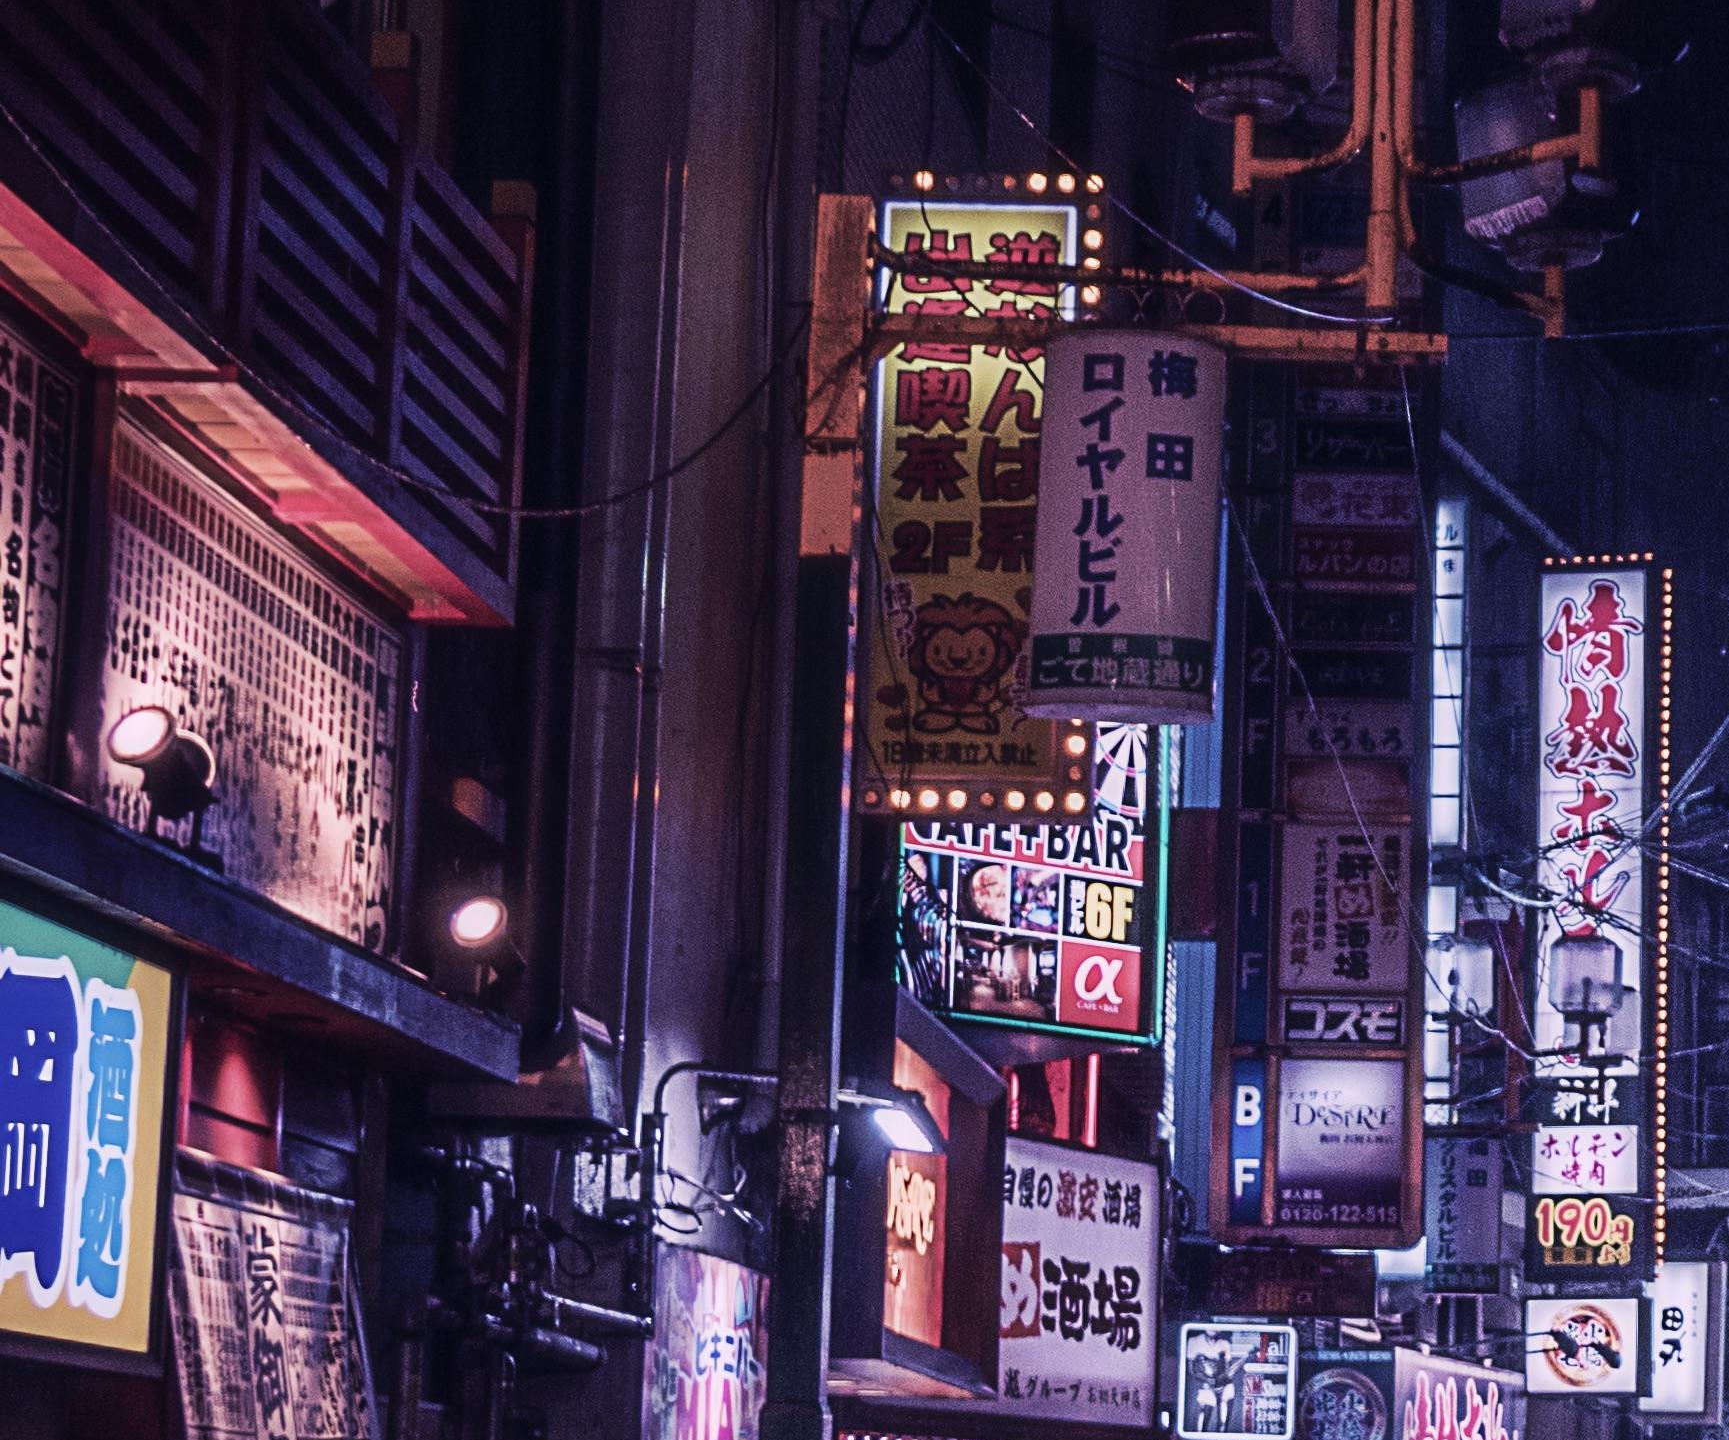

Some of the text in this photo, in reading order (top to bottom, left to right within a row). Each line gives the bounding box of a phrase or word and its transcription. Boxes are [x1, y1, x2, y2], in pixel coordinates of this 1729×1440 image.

[1146, 349, 1199, 482] 梅田
[1069, 352, 1127, 628] ロイヤルビル
[892, 519, 975, 575] 2F
[1038, 656, 1207, 690] ごて地蔵通り
[1308, 726, 1403, 753] もろもろ
[1084, 881, 1135, 941] 6F
[1287, 1001, 1399, 1040] コスモ
[1540, 1132, 1629, 1160] ホルモン
[1561, 1159, 1606, 1187] 焼肉
[1002, 1162, 1143, 1230] 自慢の激安酒場
[1280, 1204, 1398, 1223] 0120-122-515
[1535, 1198, 1635, 1247] 190円
